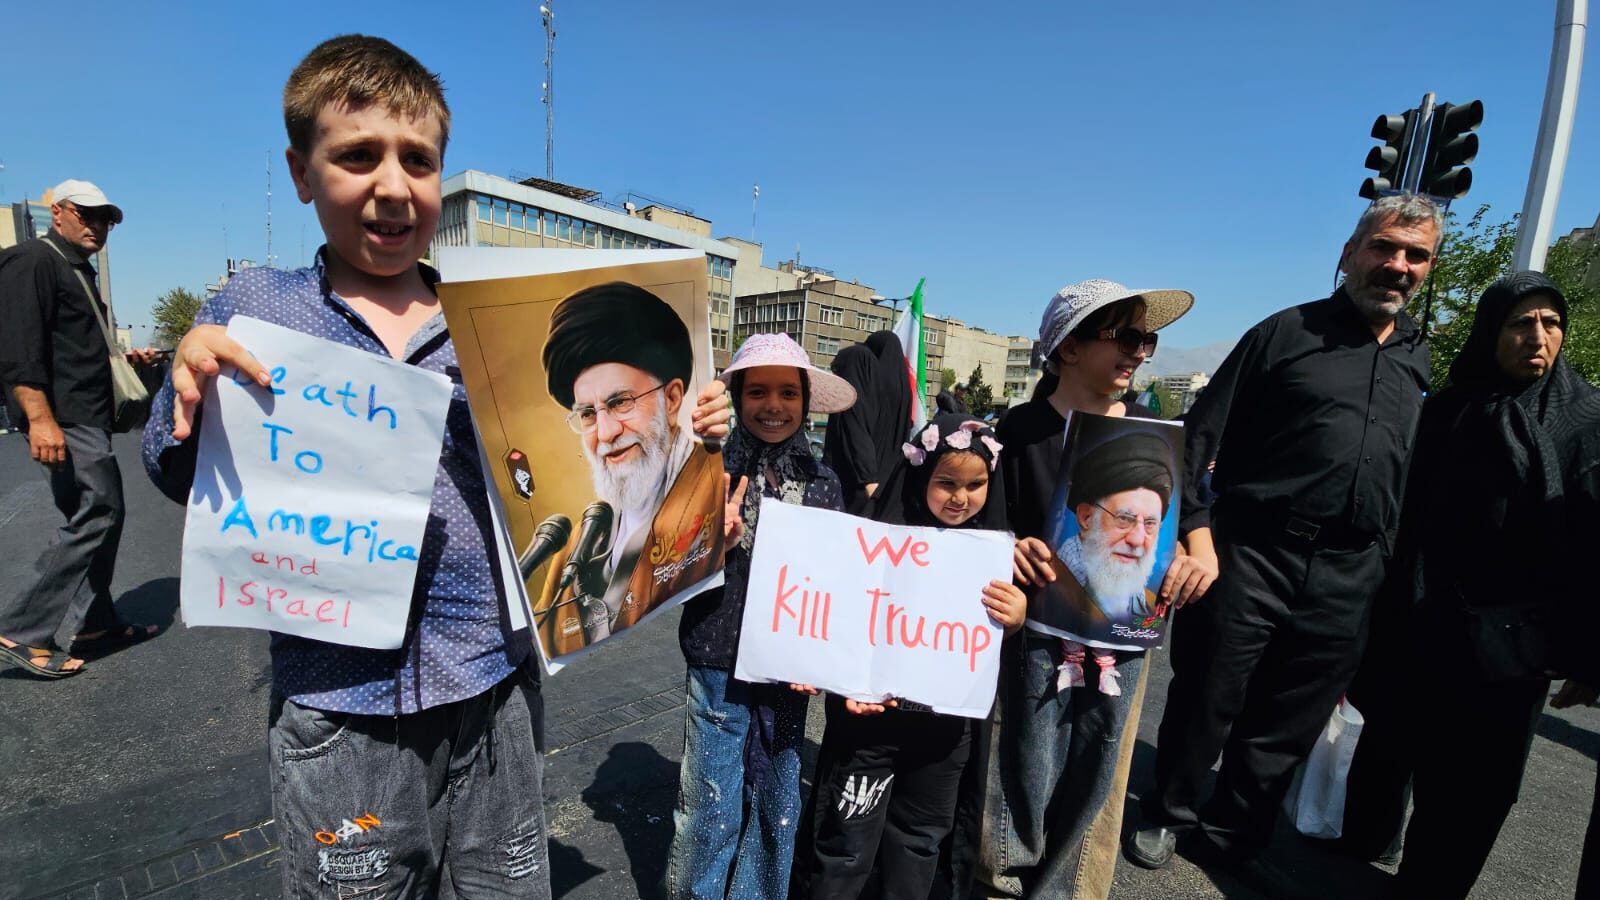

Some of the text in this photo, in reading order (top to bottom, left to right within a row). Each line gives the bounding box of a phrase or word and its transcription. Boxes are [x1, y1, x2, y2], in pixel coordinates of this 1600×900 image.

[262, 422, 324, 474] To
[220, 496, 420, 563] America
[856, 527, 930, 567] We
[250, 551, 319, 576] and
[218, 575, 351, 628] Israel
[771, 564, 831, 641] kill
[866, 588, 991, 673] Trump
